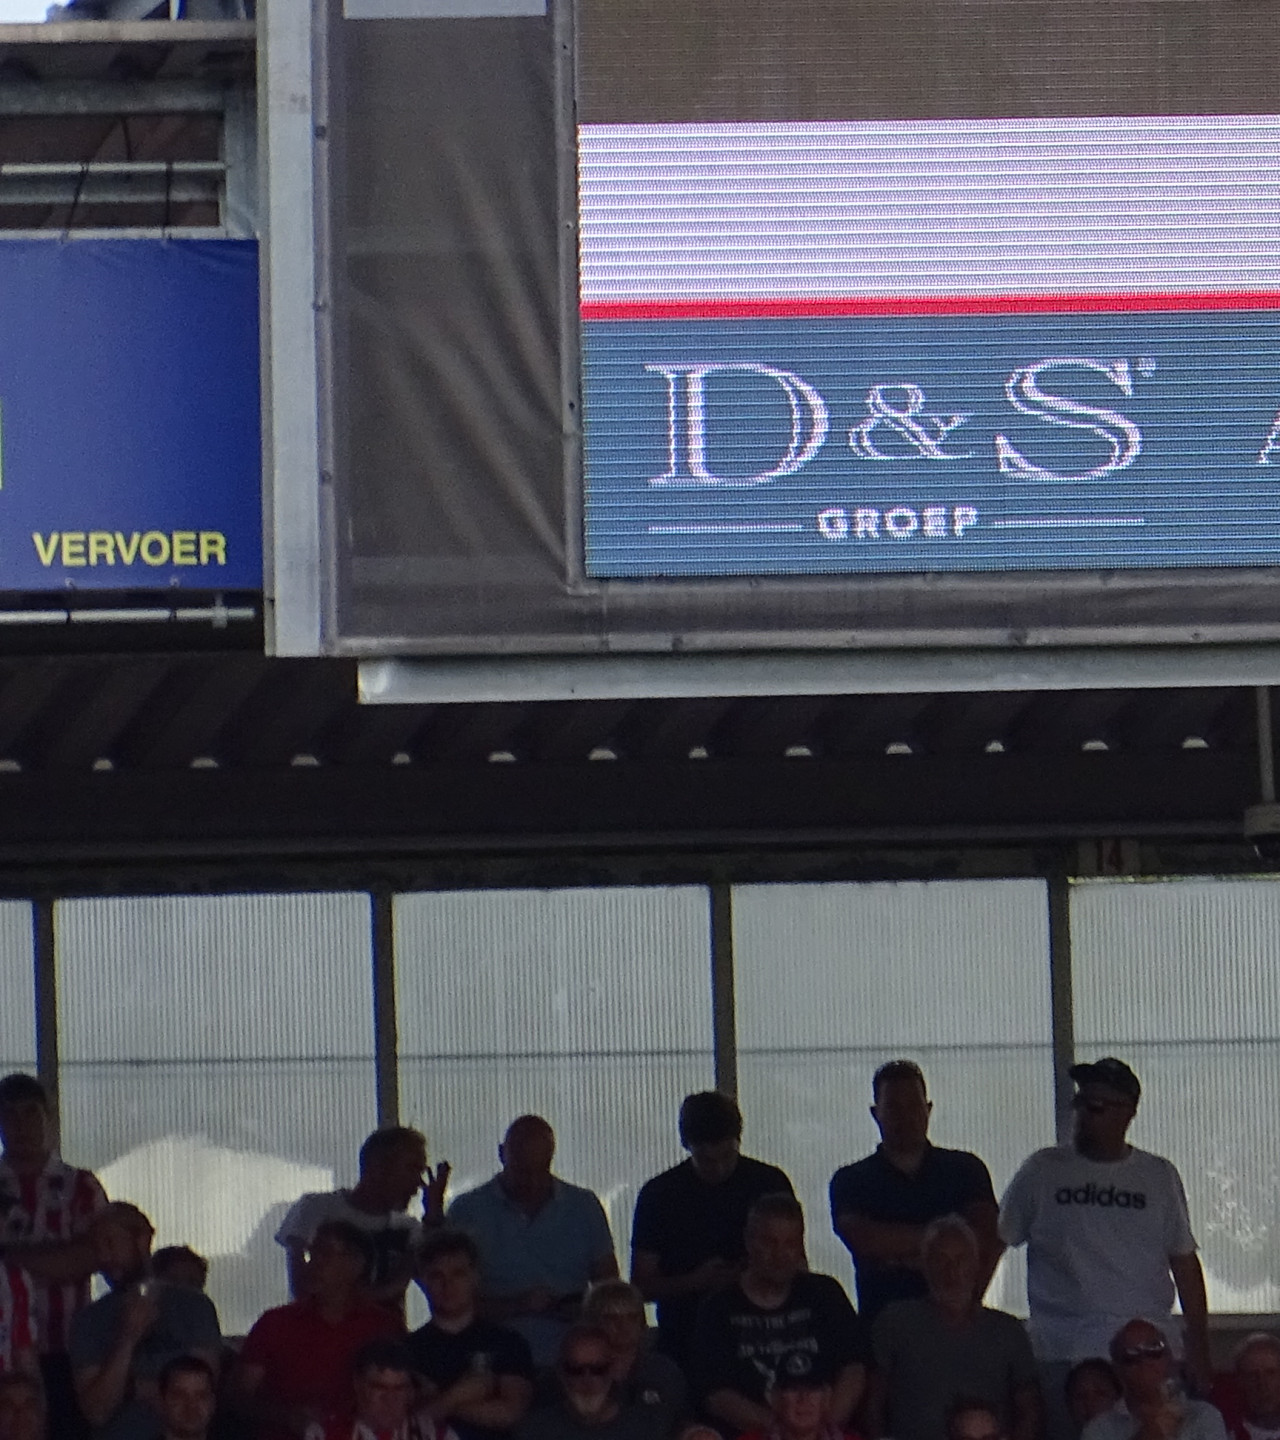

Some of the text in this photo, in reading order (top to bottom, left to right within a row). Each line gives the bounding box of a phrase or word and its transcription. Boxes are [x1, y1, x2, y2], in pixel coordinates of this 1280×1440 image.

[645, 357, 1144, 488] D&S
[817, 506, 979, 540] GROEP
[32, 531, 228, 567] VERVOER
[1055, 1182, 1146, 1210] adidas
